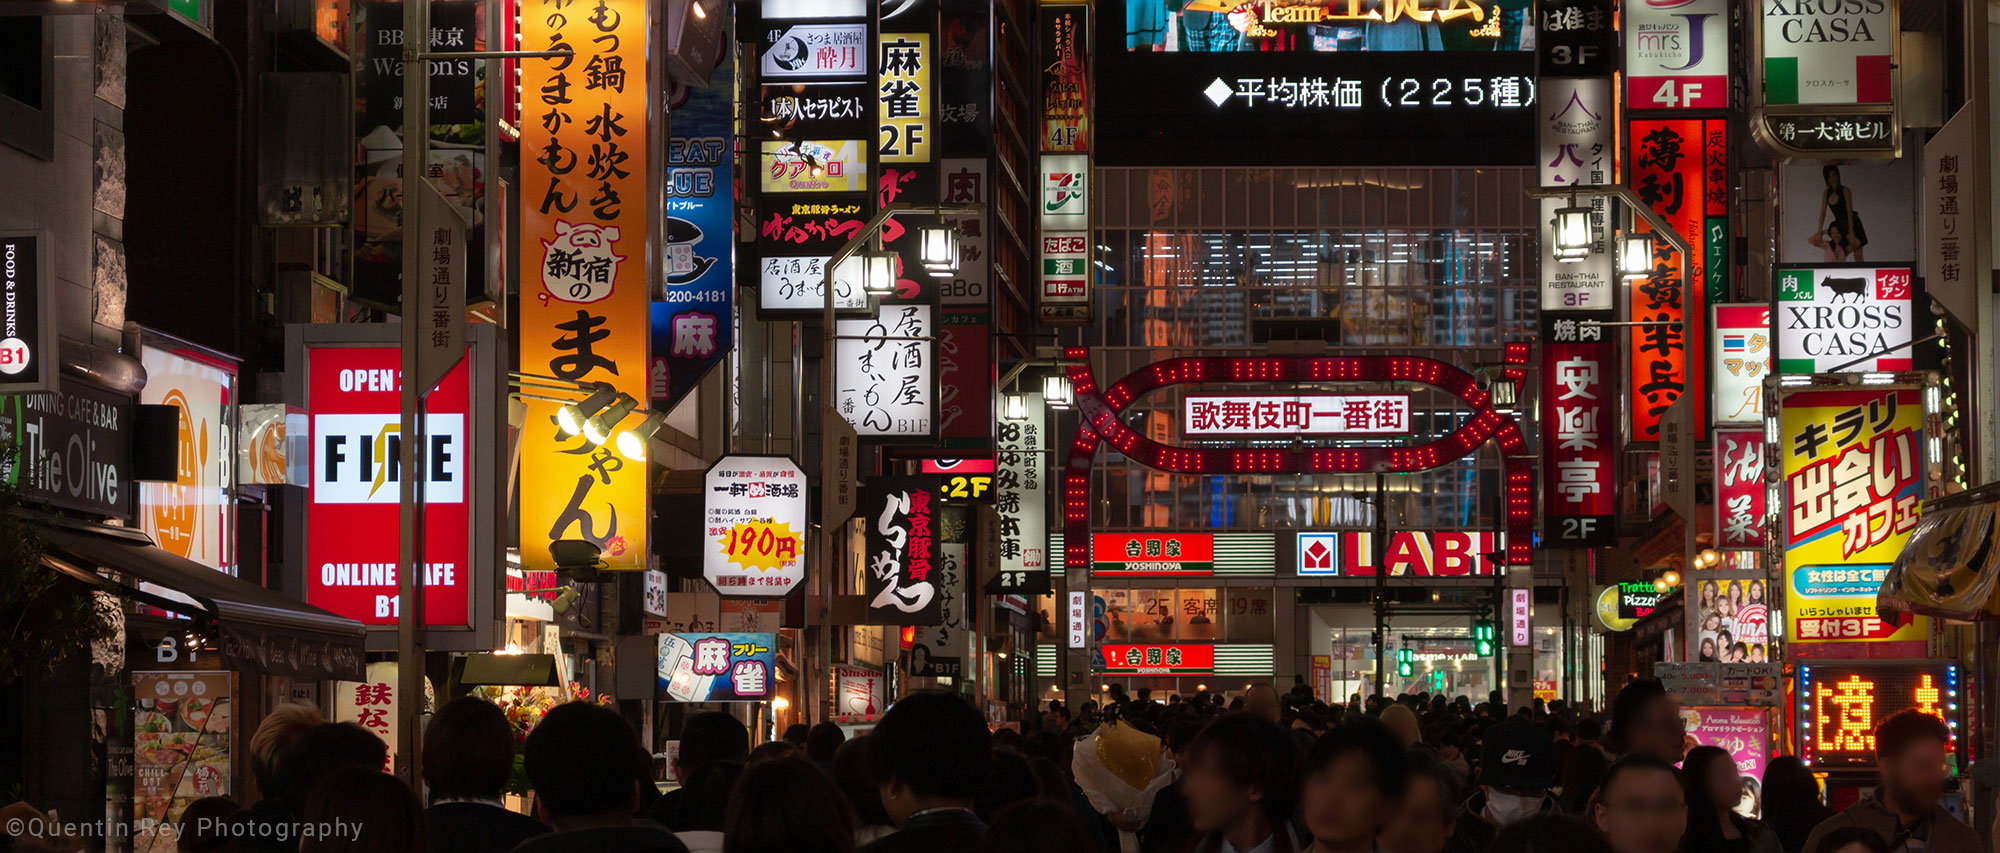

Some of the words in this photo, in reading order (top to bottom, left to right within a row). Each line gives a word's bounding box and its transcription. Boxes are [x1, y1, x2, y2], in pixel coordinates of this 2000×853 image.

[766, 29, 782, 43] 4F
[1659, 13, 1719, 71] J
[1782, 18, 1875, 44] CASA
[816, 46, 856, 69] 酔月
[1551, 44, 1600, 65] 3F
[372, 57, 470, 77] Waon's
[880, 37, 922, 119] 麻雀
[1652, 80, 1703, 107] 4F
[1804, 79, 1851, 88] クロスカーサ
[880, 123, 923, 156] 2F
[1051, 127, 1078, 146] 4F
[1779, 121, 1892, 142] 第一大滝ビル
[584, 103, 631, 221] 水炊き
[1707, 130, 1726, 205] 炭火串焼
[789, 179, 830, 190] Quattro
[791, 203, 861, 216] 東京豚骨ラーメン
[1939, 154, 1961, 282] 劇場通り一番街
[1045, 238, 1085, 253] たばこ
[5, 244, 16, 279] FOOD
[547, 247, 613, 284] 新宿
[763, 259, 823, 276] 居酒屋
[1055, 260, 1074, 275] 酒
[5, 280, 16, 290] &
[432, 227, 452, 349] 劇場通り一番街
[1548, 281, 1605, 289] RESTAURANT
[1555, 273, 1600, 281] BAN-THAI
[1782, 275, 1798, 292] 肉
[1563, 292, 1590, 306] 3F
[1793, 290, 1813, 300] バル
[5, 291, 16, 338] DRINKS
[1787, 305, 1903, 330] XROSS
[1554, 319, 1601, 342] 焼肉
[1802, 331, 1893, 356] CASA
[891, 306, 925, 406] 居酒屋
[339, 369, 392, 392] OPEN
[68, 395, 91, 425] CAFE
[100, 404, 118, 432] BAR
[1190, 399, 1404, 431] 歌舞伎町一番街
[897, 418, 929, 433] B1F
[1556, 356, 1600, 503] 安楽亭
[1794, 391, 1898, 461] キラリ
[26, 417, 63, 494] The
[66, 429, 118, 506] Olive
[713, 481, 800, 499] 一軒め酒場
[1792, 431, 1914, 537] 出会い
[908, 488, 932, 581] 東京豚骨
[1561, 517, 1597, 540] 2F
[1843, 494, 1920, 558] カフェ
[728, 526, 797, 559] 190円
[1124, 538, 1182, 557] 吉野家
[321, 562, 397, 587] ONLINE
[424, 561, 455, 586] AFE
[1124, 561, 1183, 571] YOSHINOYA
[1001, 571, 1027, 588] 2F
[1183, 596, 1219, 616] 客席
[1515, 591, 1527, 643] 劇場通り
[1071, 595, 1083, 645] 劇場通り
[1799, 618, 1882, 639] 受付3F
[733, 643, 769, 657] フリー
[1126, 646, 1183, 666] 吉野家
[138, 767, 166, 778] CHILL
